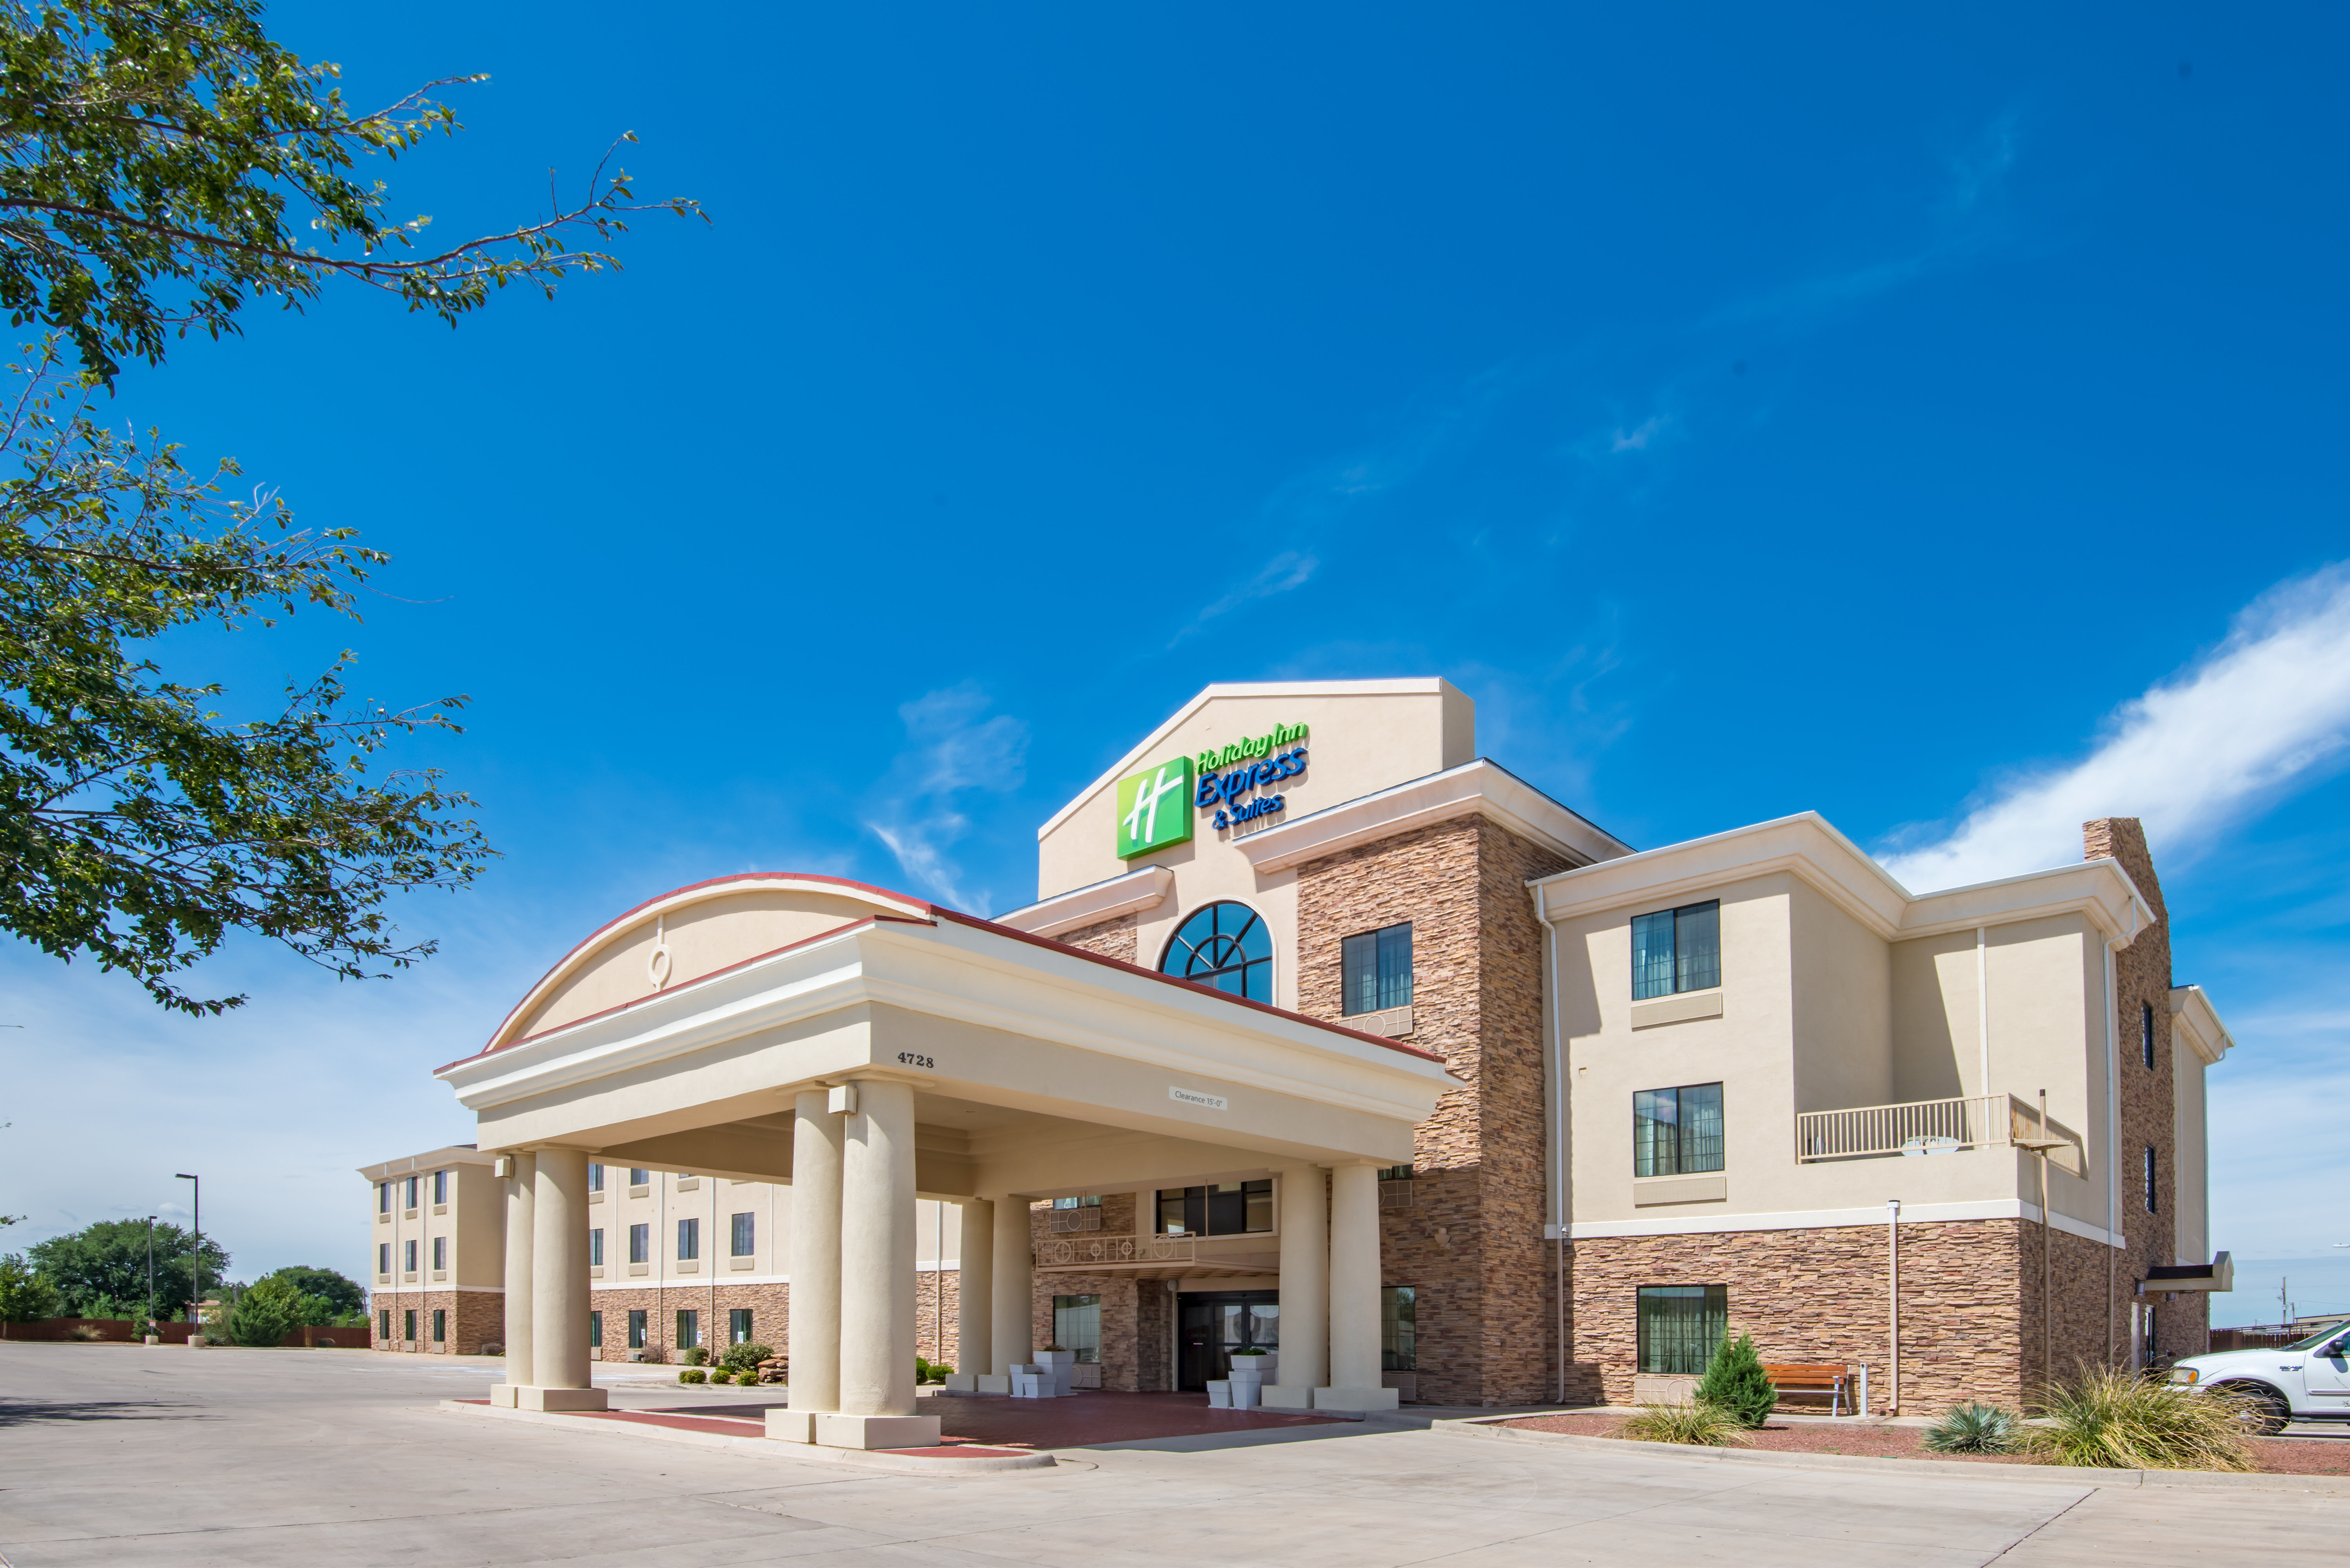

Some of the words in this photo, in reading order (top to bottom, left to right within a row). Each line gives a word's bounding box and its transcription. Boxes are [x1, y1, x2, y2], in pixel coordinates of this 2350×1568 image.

[1194, 734, 1272, 776] Holiday
[1272, 722, 1308, 747] Inn
[1195, 748, 1307, 809] Express
[1212, 809, 1228, 830] &
[1227, 794, 1285, 826] Suites
[898, 1052, 934, 1068] 4728
[1175, 1091, 1205, 1103] Clearance
